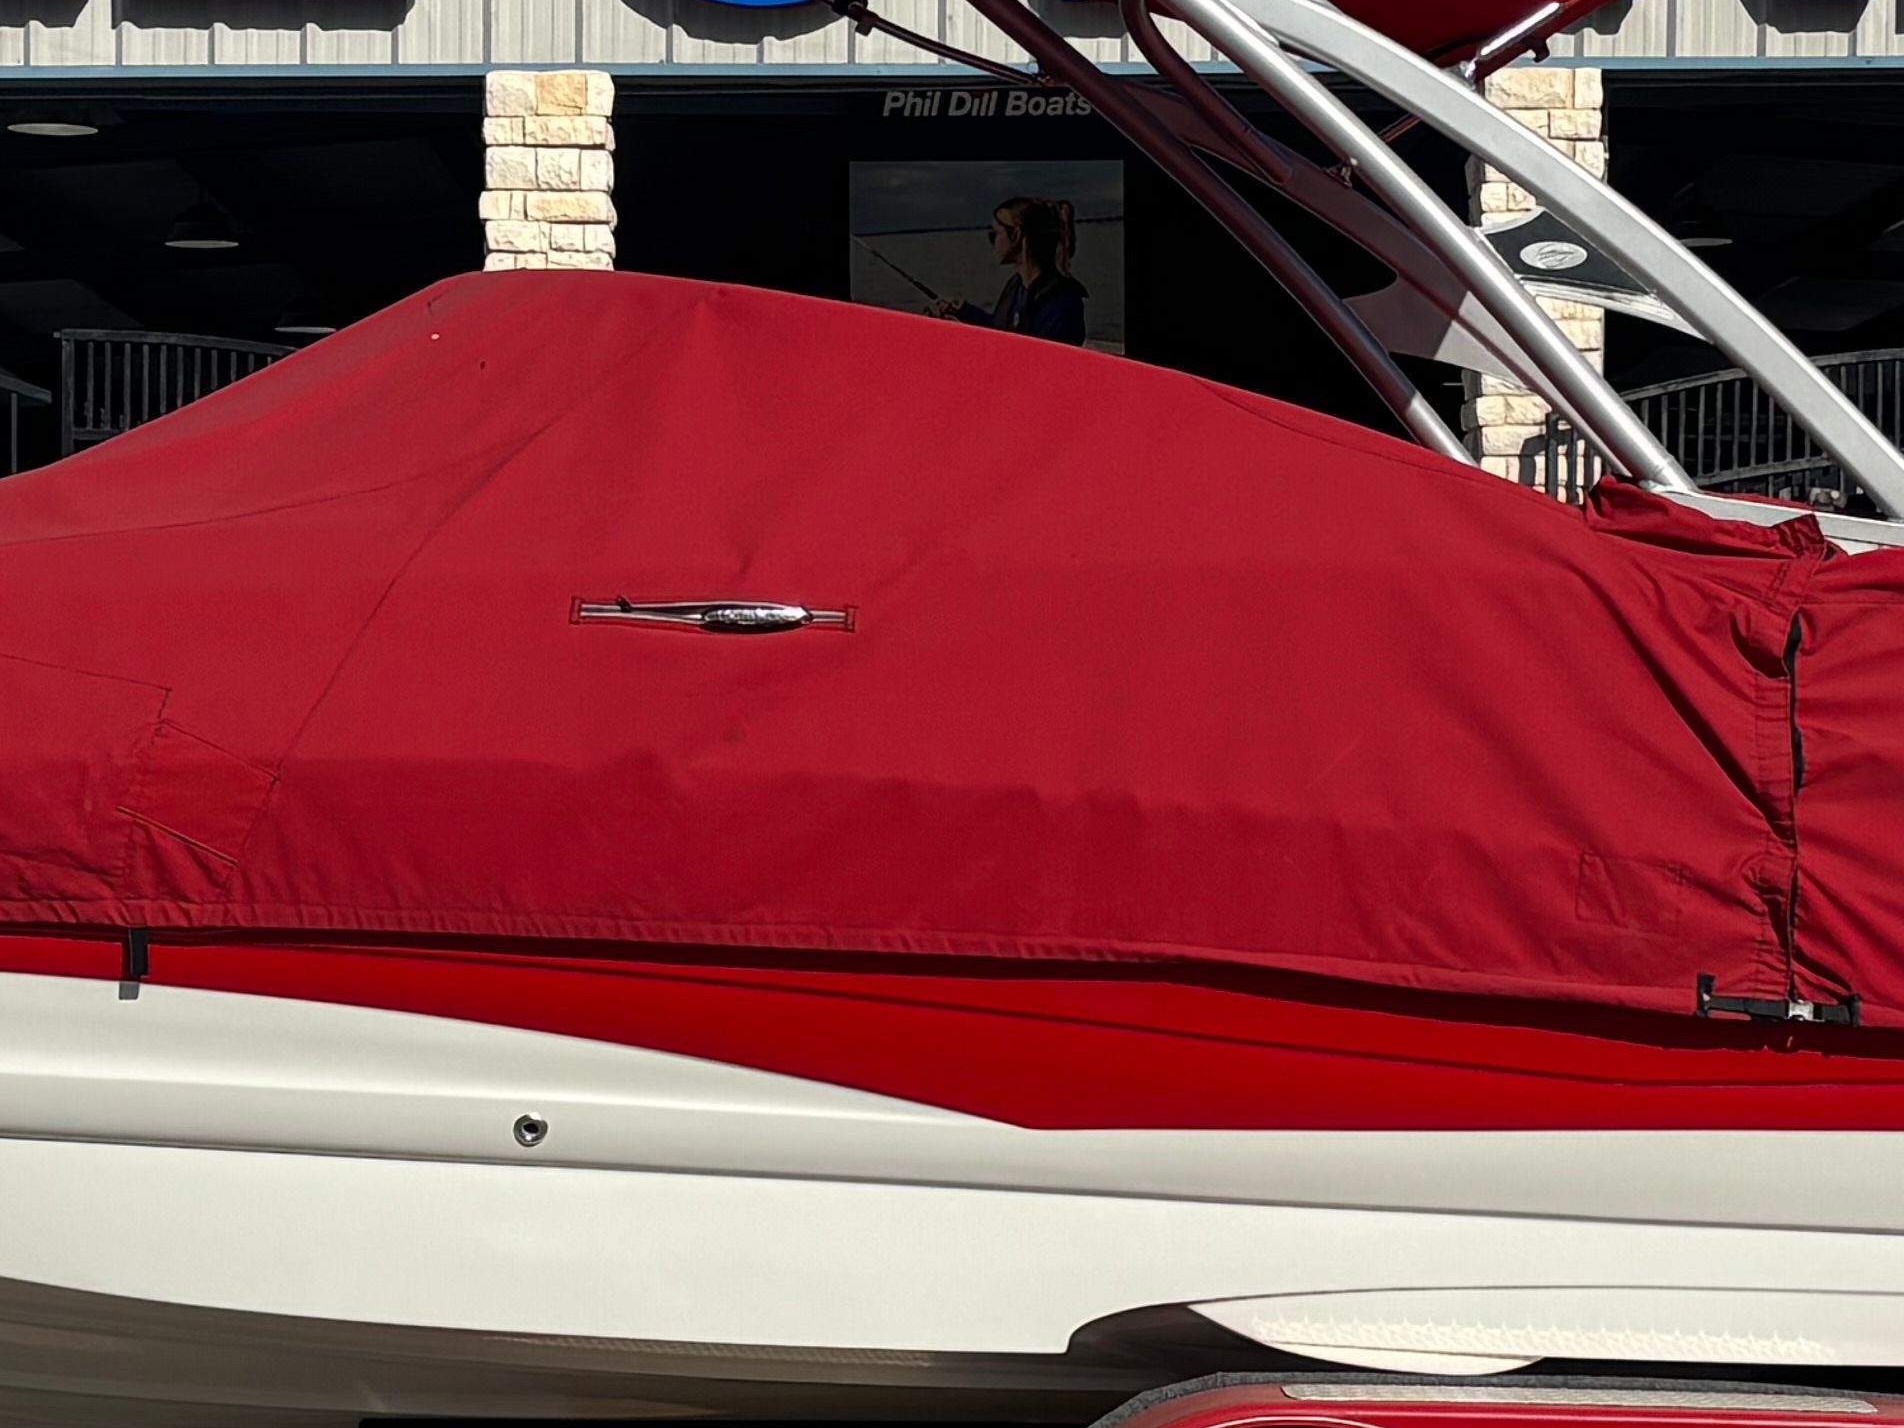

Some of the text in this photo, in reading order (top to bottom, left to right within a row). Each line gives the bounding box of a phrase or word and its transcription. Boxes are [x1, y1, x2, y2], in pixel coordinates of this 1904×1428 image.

[883, 91, 1091, 117] Phil Dill Boats
